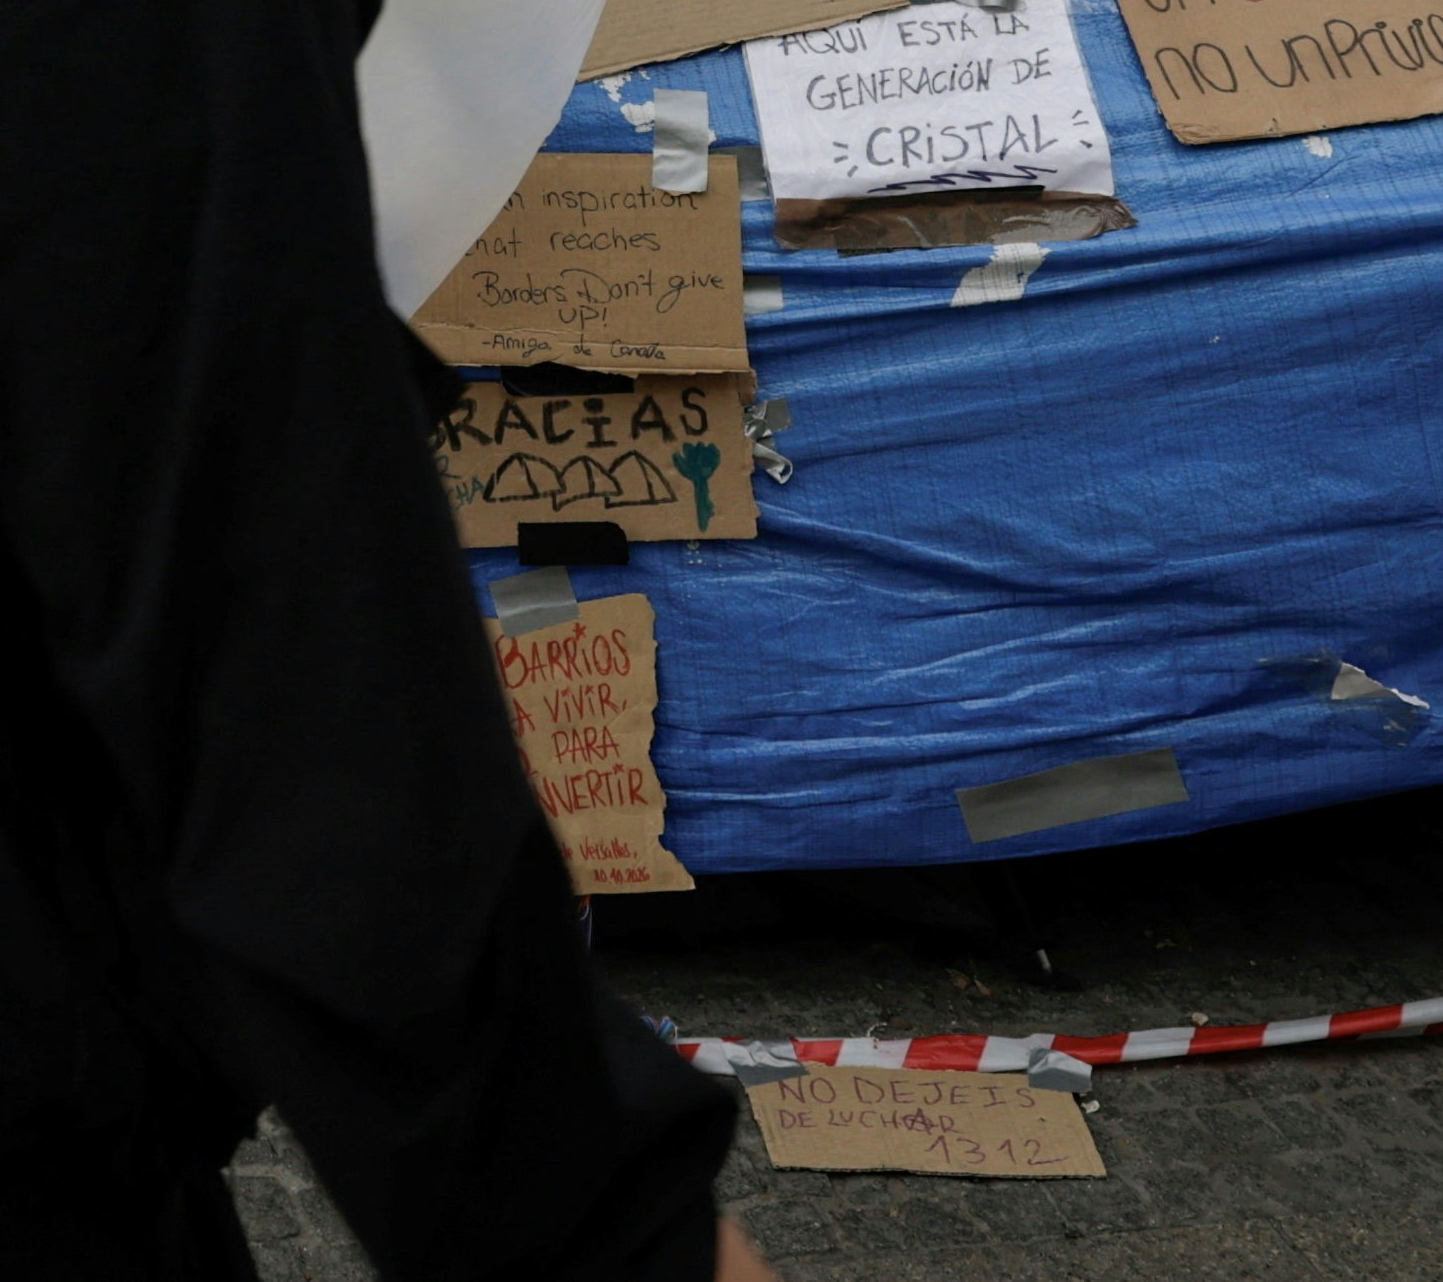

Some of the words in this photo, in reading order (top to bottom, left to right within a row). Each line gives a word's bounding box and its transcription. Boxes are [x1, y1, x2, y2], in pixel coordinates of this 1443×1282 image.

[897, 16, 979, 47] ESTÁ
[994, 14, 1031, 36] LA
[1011, 48, 1053, 85] DE
[541, 189, 699, 226] inspiration
[550, 229, 662, 253] reaches
[472, 269, 567, 308] Borders
[655, 272, 725, 314] give
[551, 725, 620, 765] PARA
[778, 1076, 836, 1106] NO
[853, 1075, 1037, 1107] DEJEIS
[827, 1107, 963, 1136] LUCHAR
[924, 1136, 1071, 1166] 1312
